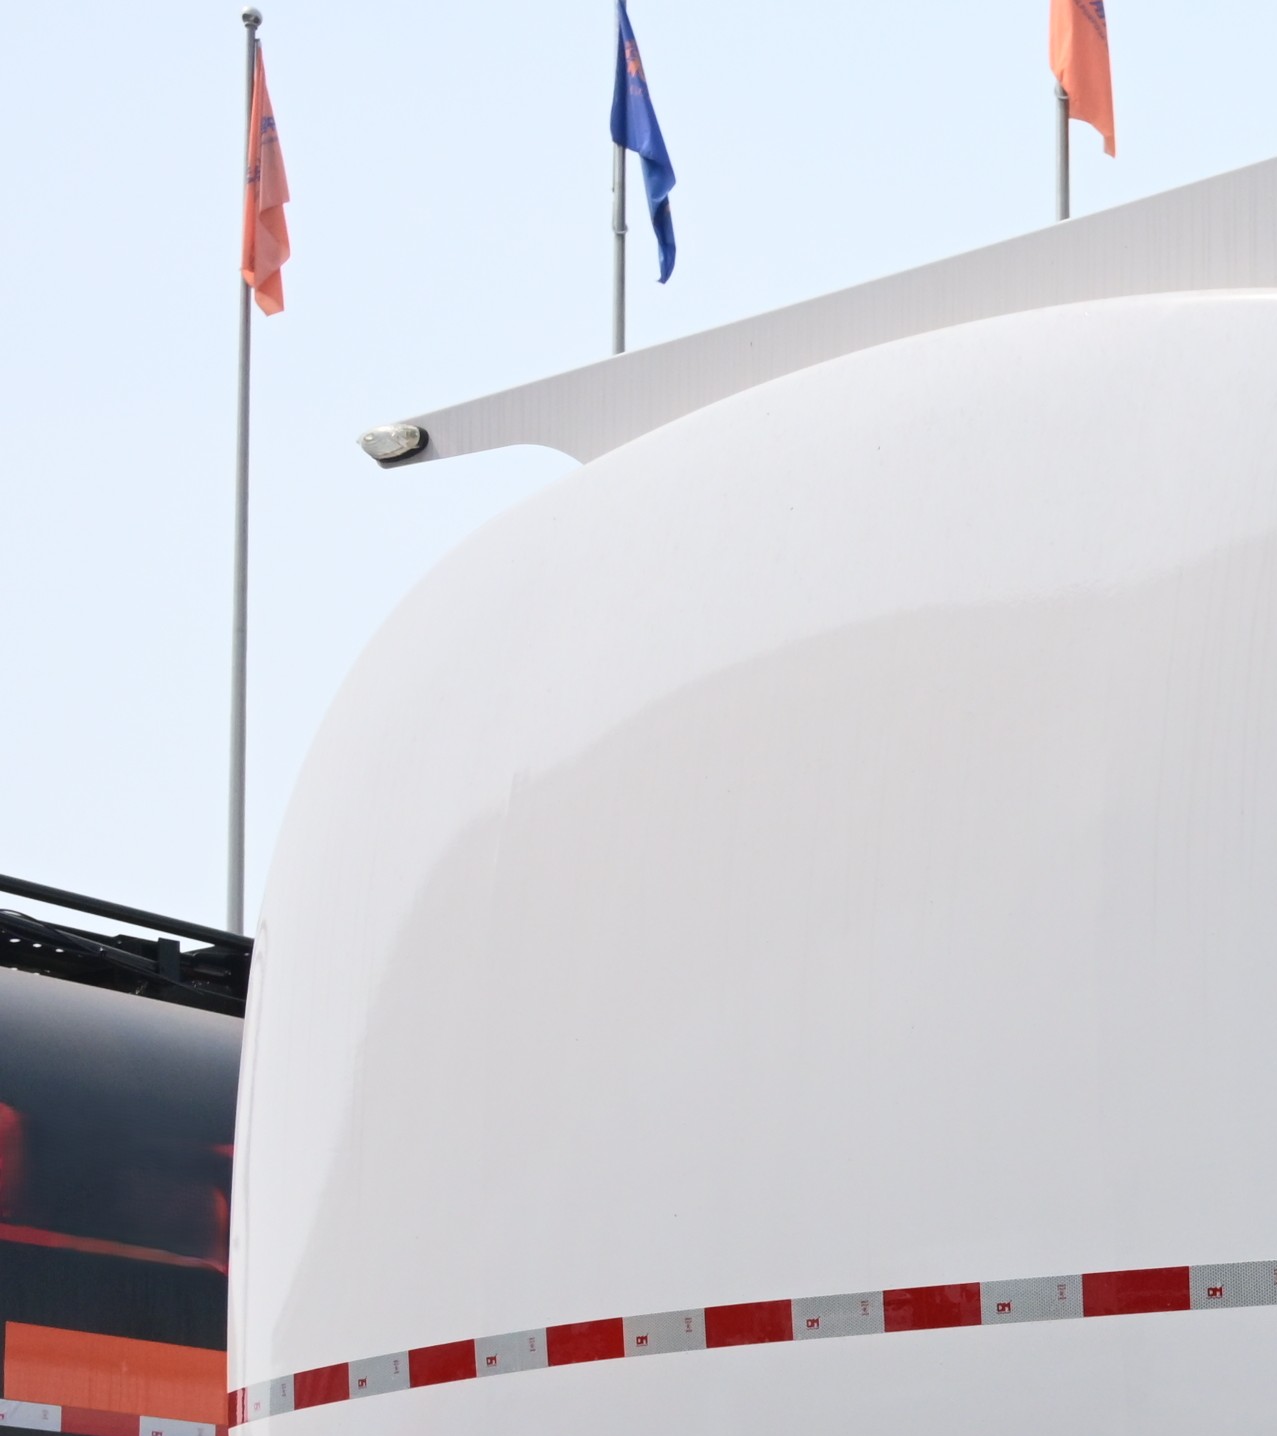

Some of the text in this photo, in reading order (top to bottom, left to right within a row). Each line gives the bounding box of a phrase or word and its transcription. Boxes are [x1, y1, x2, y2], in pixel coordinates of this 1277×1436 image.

[1208, 1286, 1224, 1298] DM
[997, 1302, 1012, 1313] DM
[807, 1317, 821, 1328] DM
[635, 1335, 649, 1346] DM
[486, 1355, 497, 1366] DM
